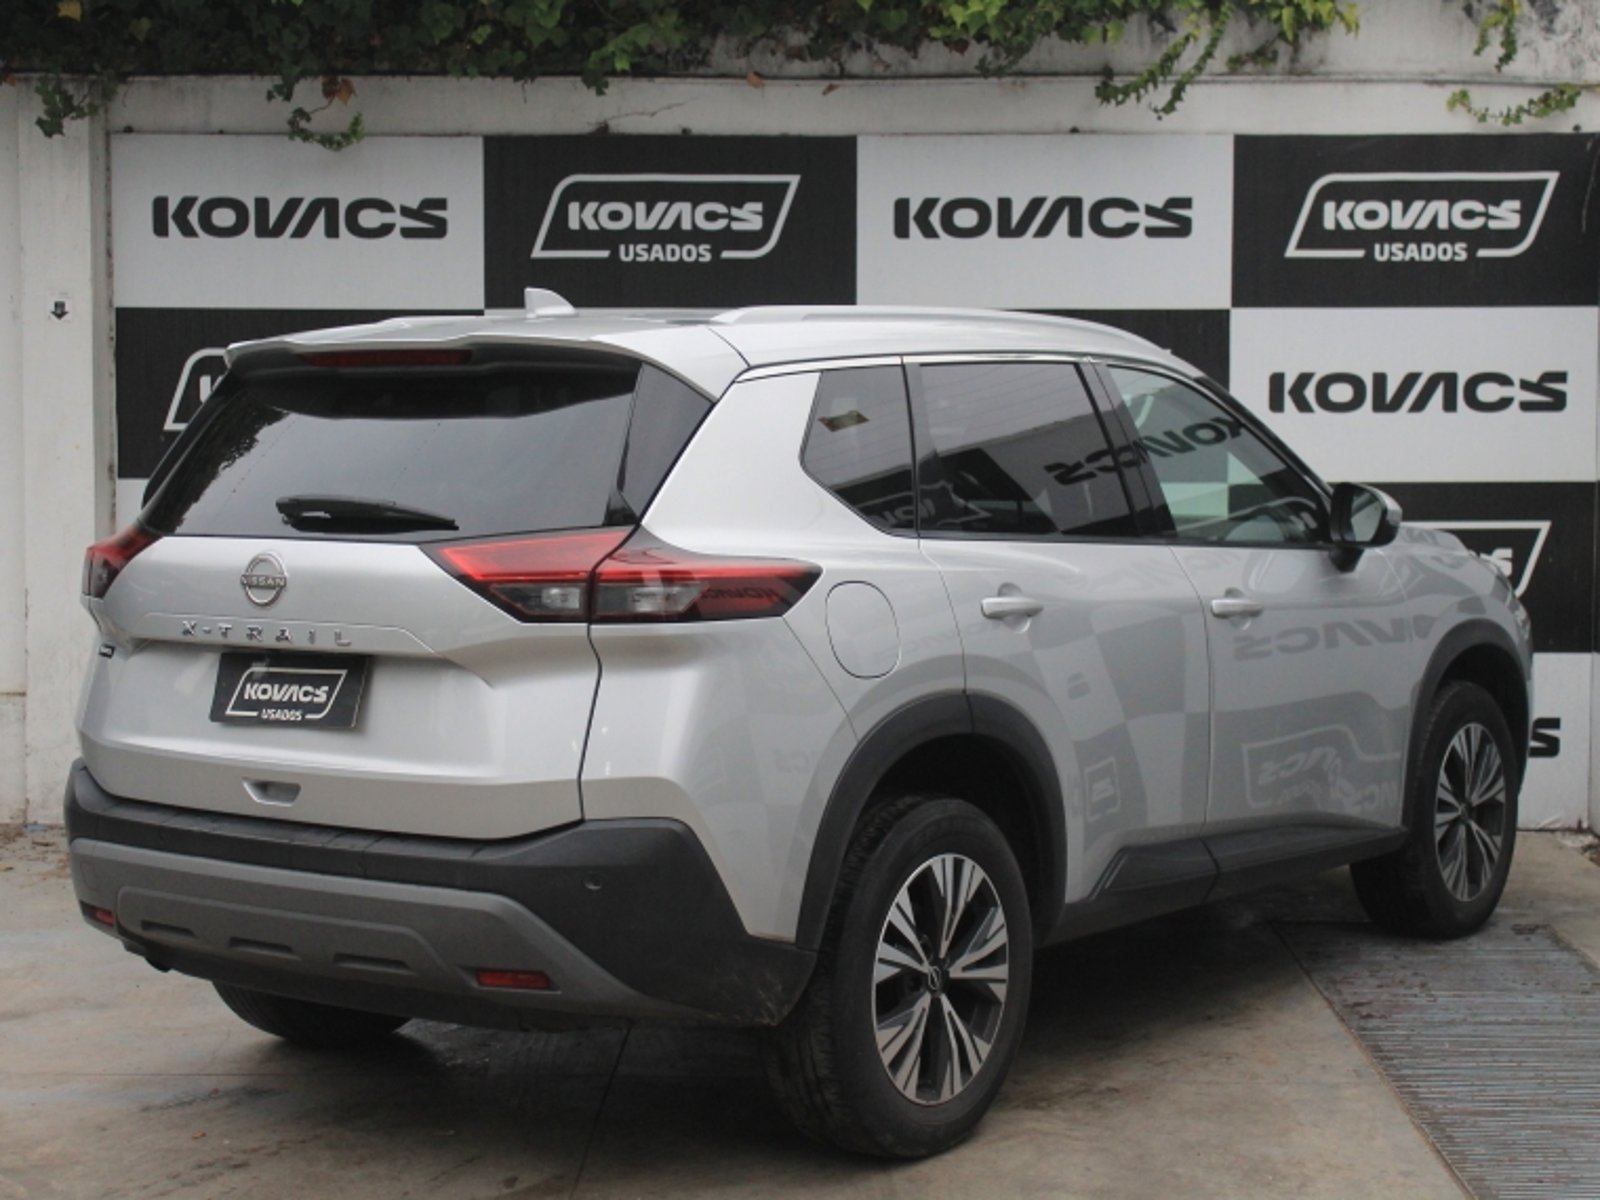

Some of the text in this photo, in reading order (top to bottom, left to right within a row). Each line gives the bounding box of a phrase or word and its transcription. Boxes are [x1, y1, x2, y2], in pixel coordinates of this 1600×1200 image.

[152, 196, 448, 239] KOVACS
[567, 200, 764, 231] KOVACS
[894, 196, 1193, 239] KOVACS
[1322, 199, 1522, 231] KOVACS
[618, 242, 713, 263] USADOS
[1373, 241, 1469, 263] USADOS
[1268, 371, 1568, 413] KOVACS
[241, 575, 286, 588] NISSAN
[182, 620, 352, 646] X-TRAIL
[243, 682, 329, 703] KOVACS
[260, 708, 303, 721] USADOS
